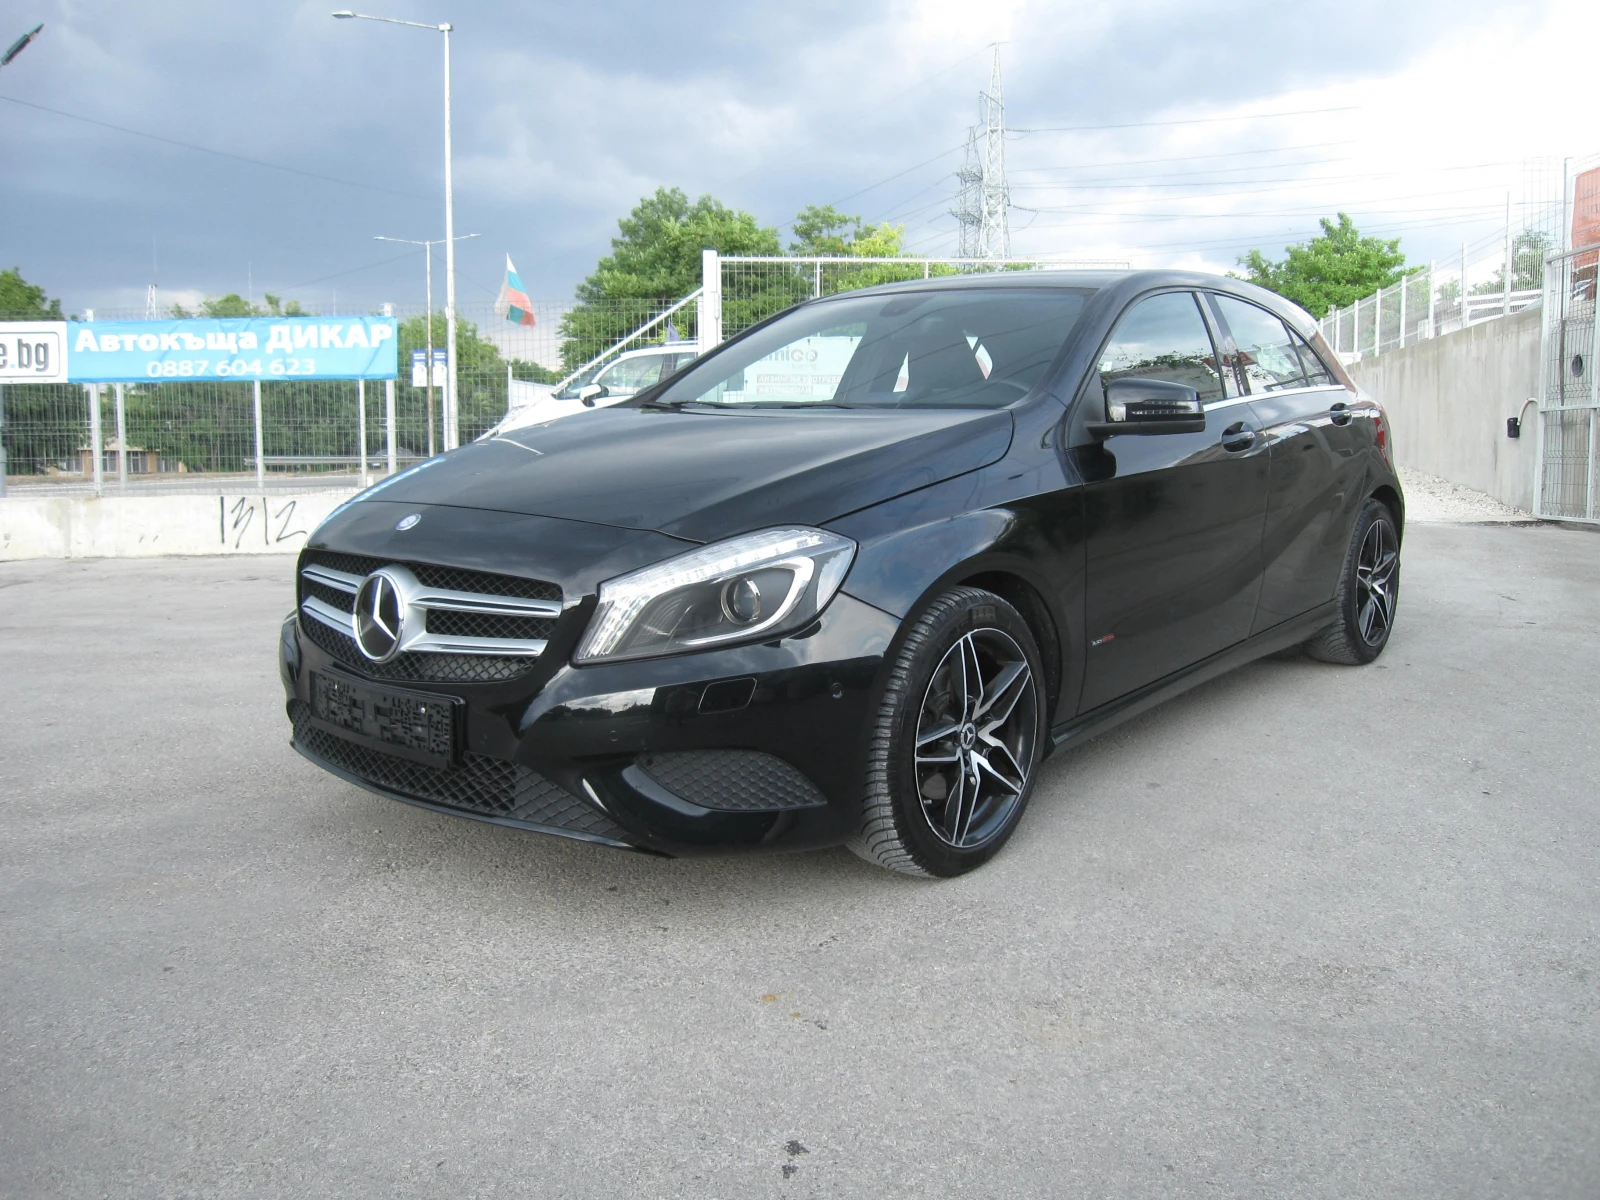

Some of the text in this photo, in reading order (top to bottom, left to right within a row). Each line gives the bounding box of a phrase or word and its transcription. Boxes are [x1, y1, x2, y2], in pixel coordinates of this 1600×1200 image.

[75, 324, 393, 354] Автокъща ДИКАР
[146, 358, 316, 377] 0887 604 623
